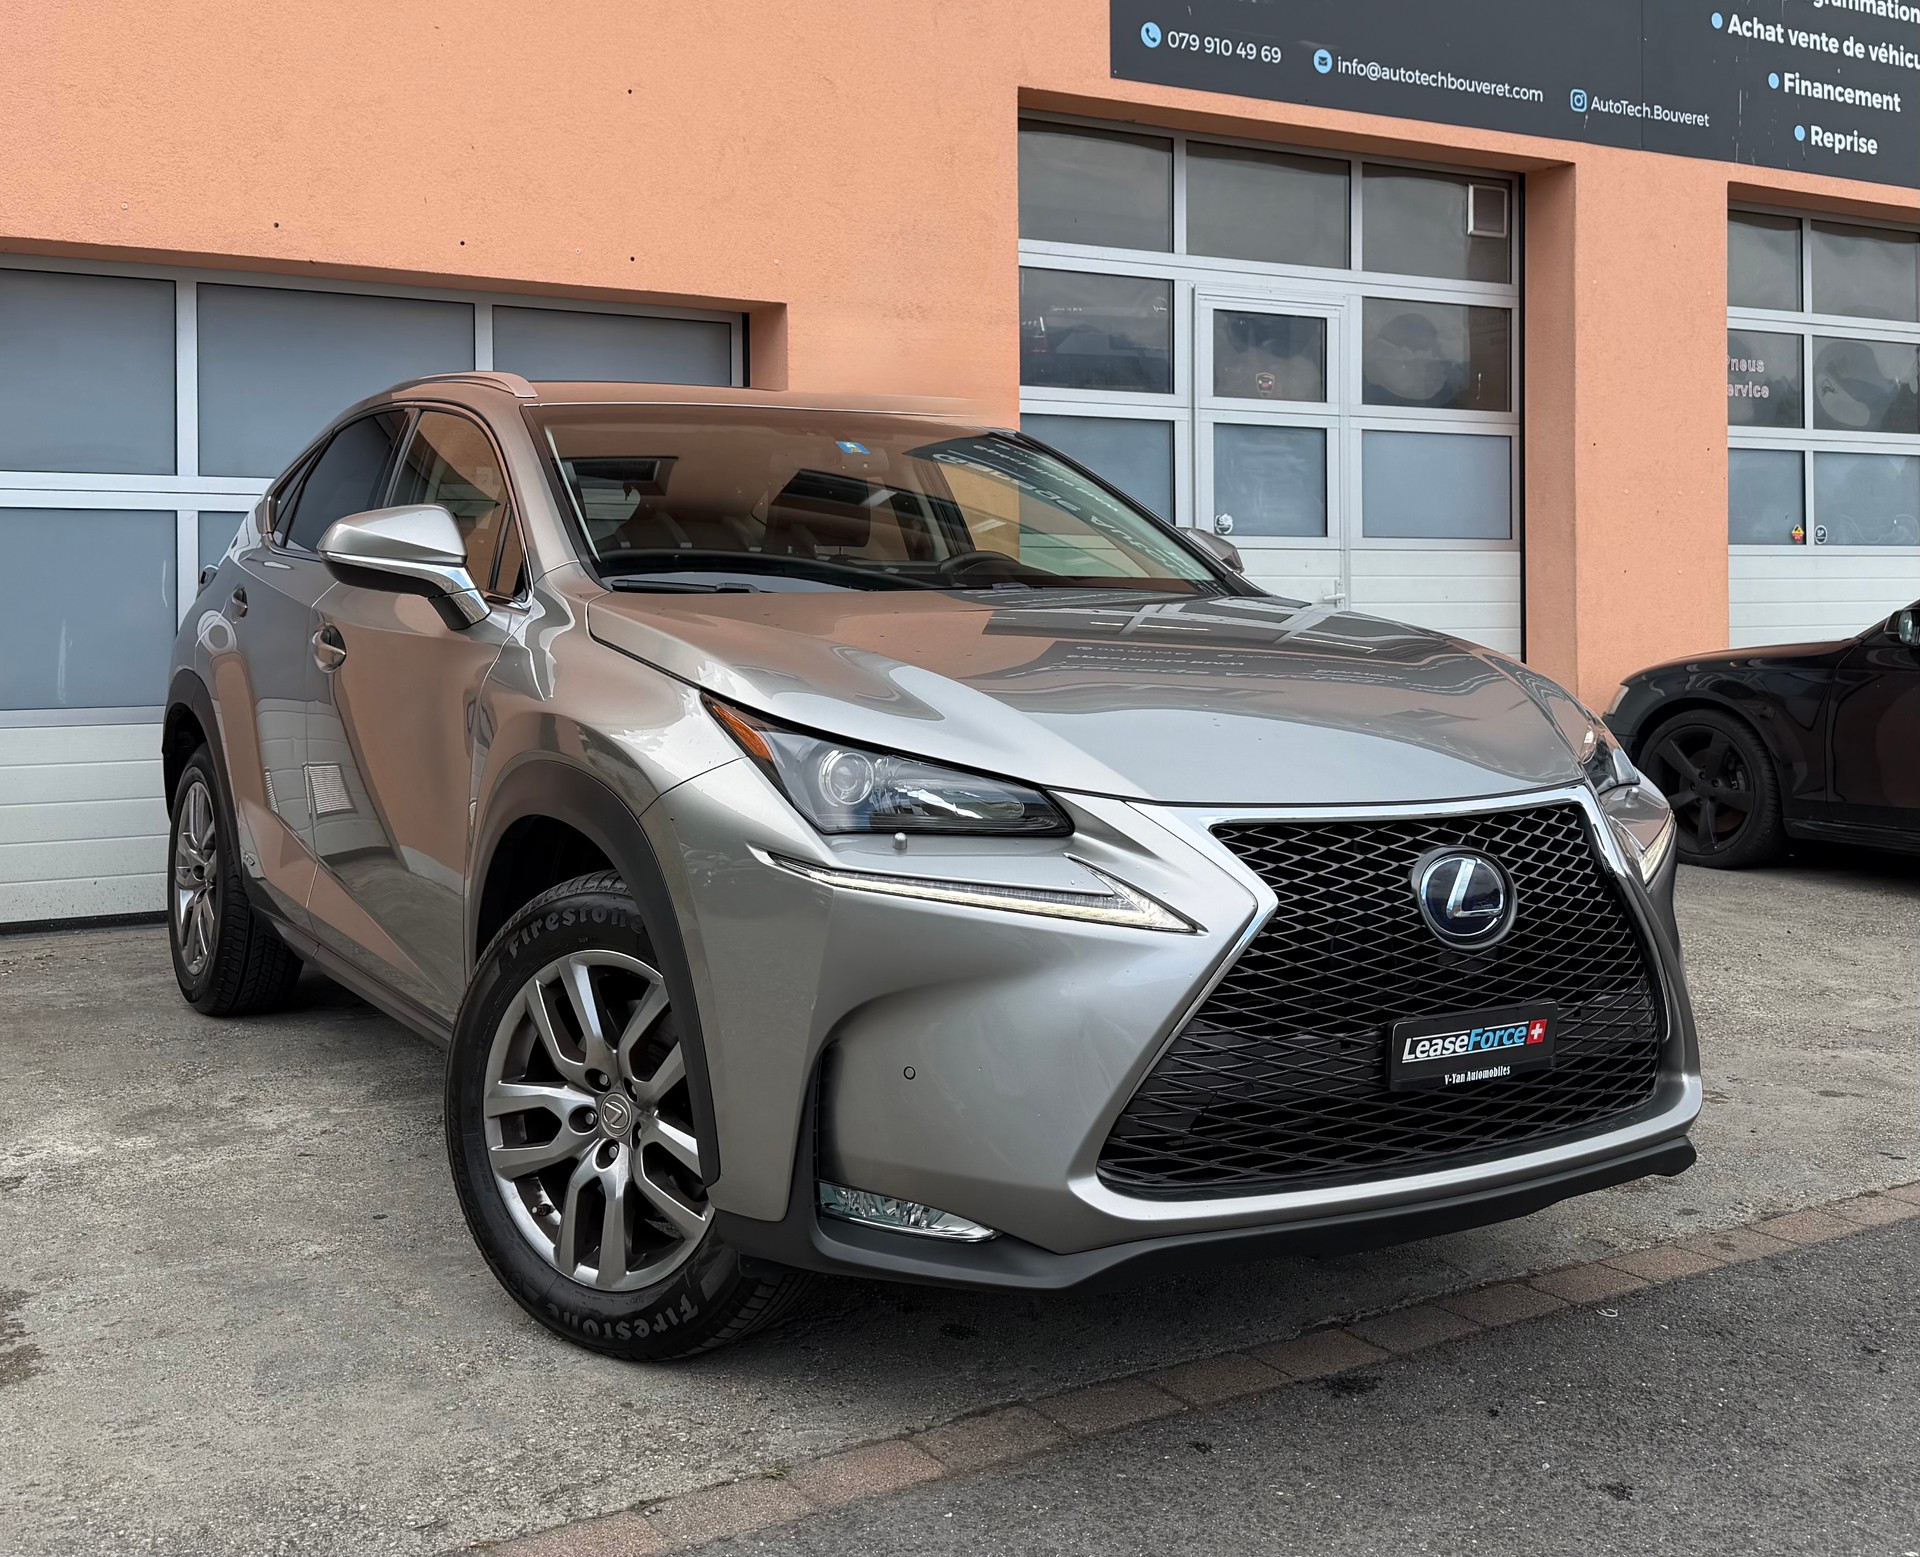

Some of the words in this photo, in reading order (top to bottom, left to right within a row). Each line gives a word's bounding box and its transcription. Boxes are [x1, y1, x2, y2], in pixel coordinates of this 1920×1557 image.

[1813, 0, 1920, 24] mmation
[1167, 31, 1200, 51] 079
[1204, 36, 1232, 56] 910
[1236, 41, 1257, 60] 49
[1260, 45, 1281, 63] 69
[1727, 13, 1785, 43] Achat
[1788, 29, 1839, 54] vente
[1842, 36, 1865, 58] de
[1337, 56, 1544, 102] info@autotechbouveret.com
[1784, 72, 1901, 112] Financement
[1591, 96, 1710, 127] AutoTech.Bouveret
[1810, 125, 1878, 155] Reprise
[504, 904, 644, 959] Firestone
[1402, 1026, 1527, 1061] LeaseForce
[1466, 1065, 1511, 1082] Automobiles
